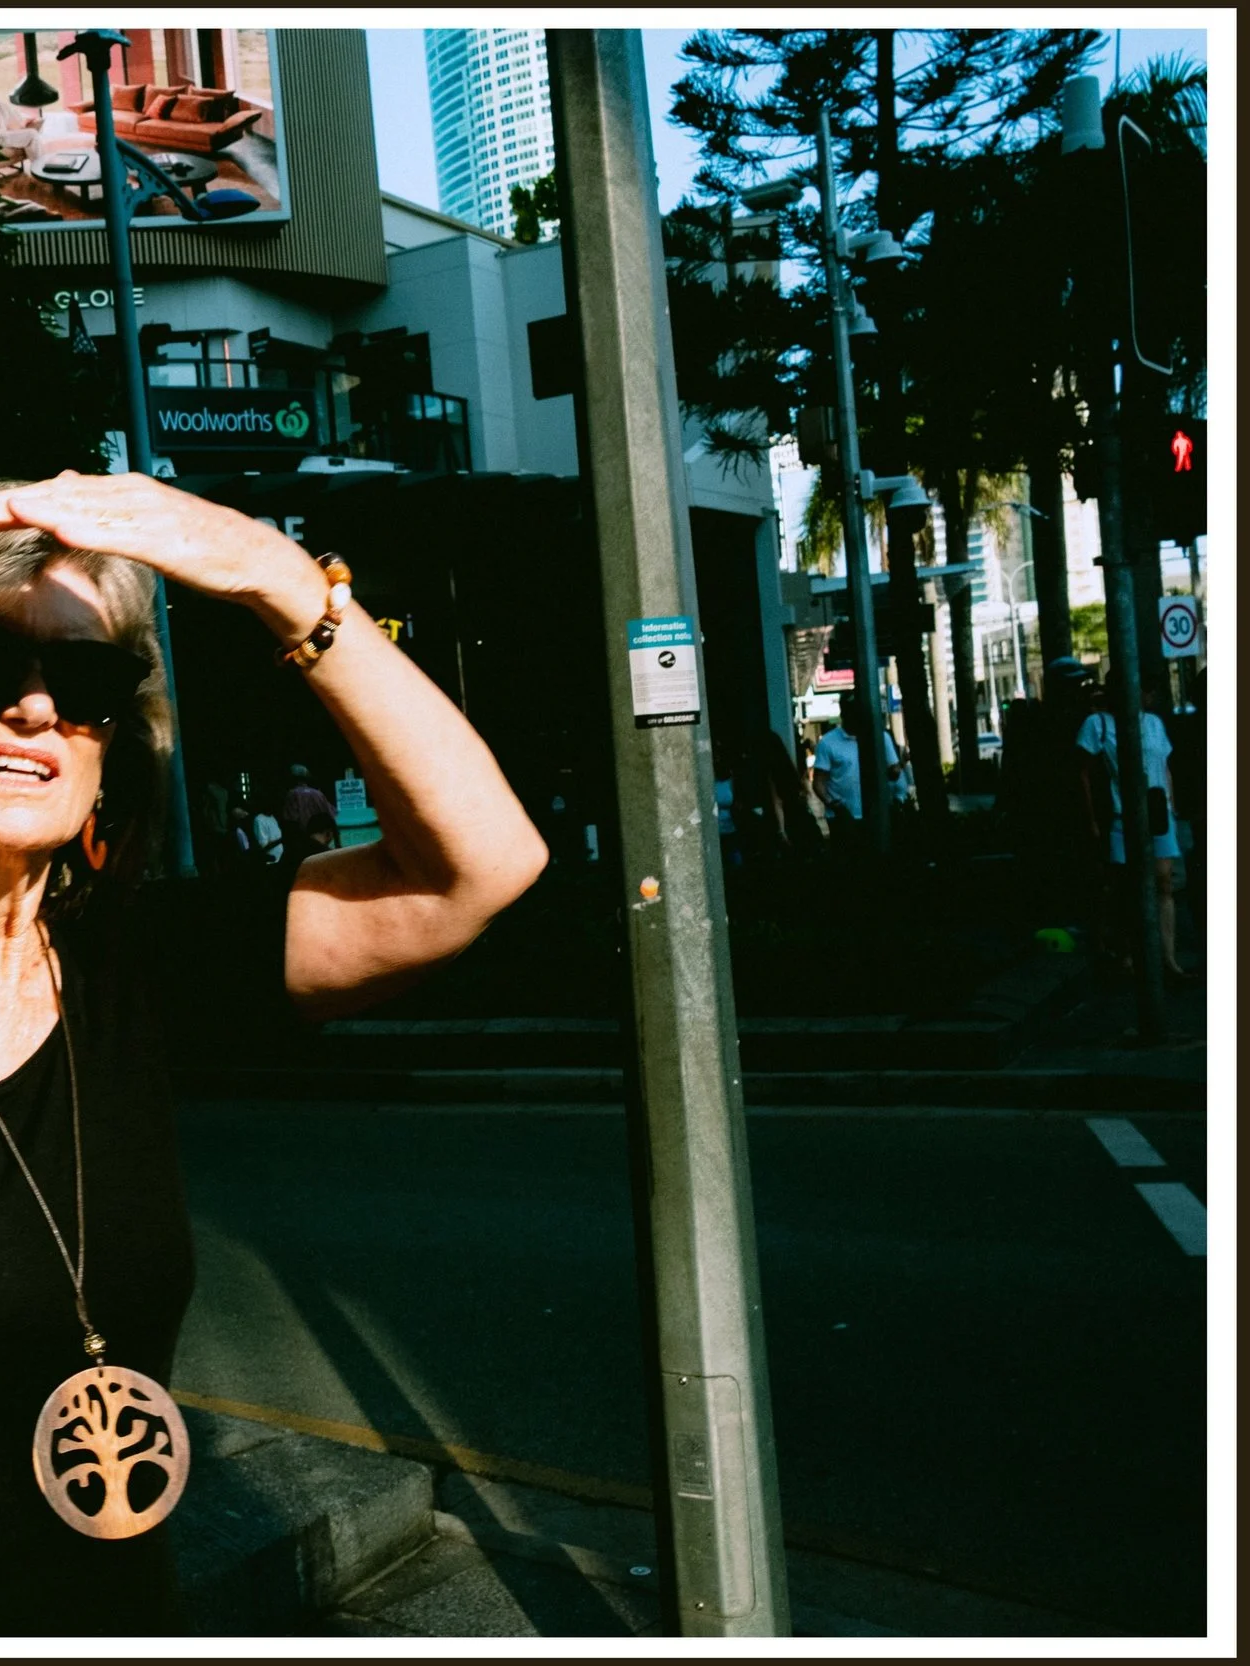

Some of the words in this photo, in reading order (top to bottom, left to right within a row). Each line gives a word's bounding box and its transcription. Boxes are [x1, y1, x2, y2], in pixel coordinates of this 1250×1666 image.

[53, 287, 145, 310] GLOE
[158, 406, 274, 433] Woolworths
[1169, 616, 1191, 636] 30
[633, 634, 673, 644] collection
